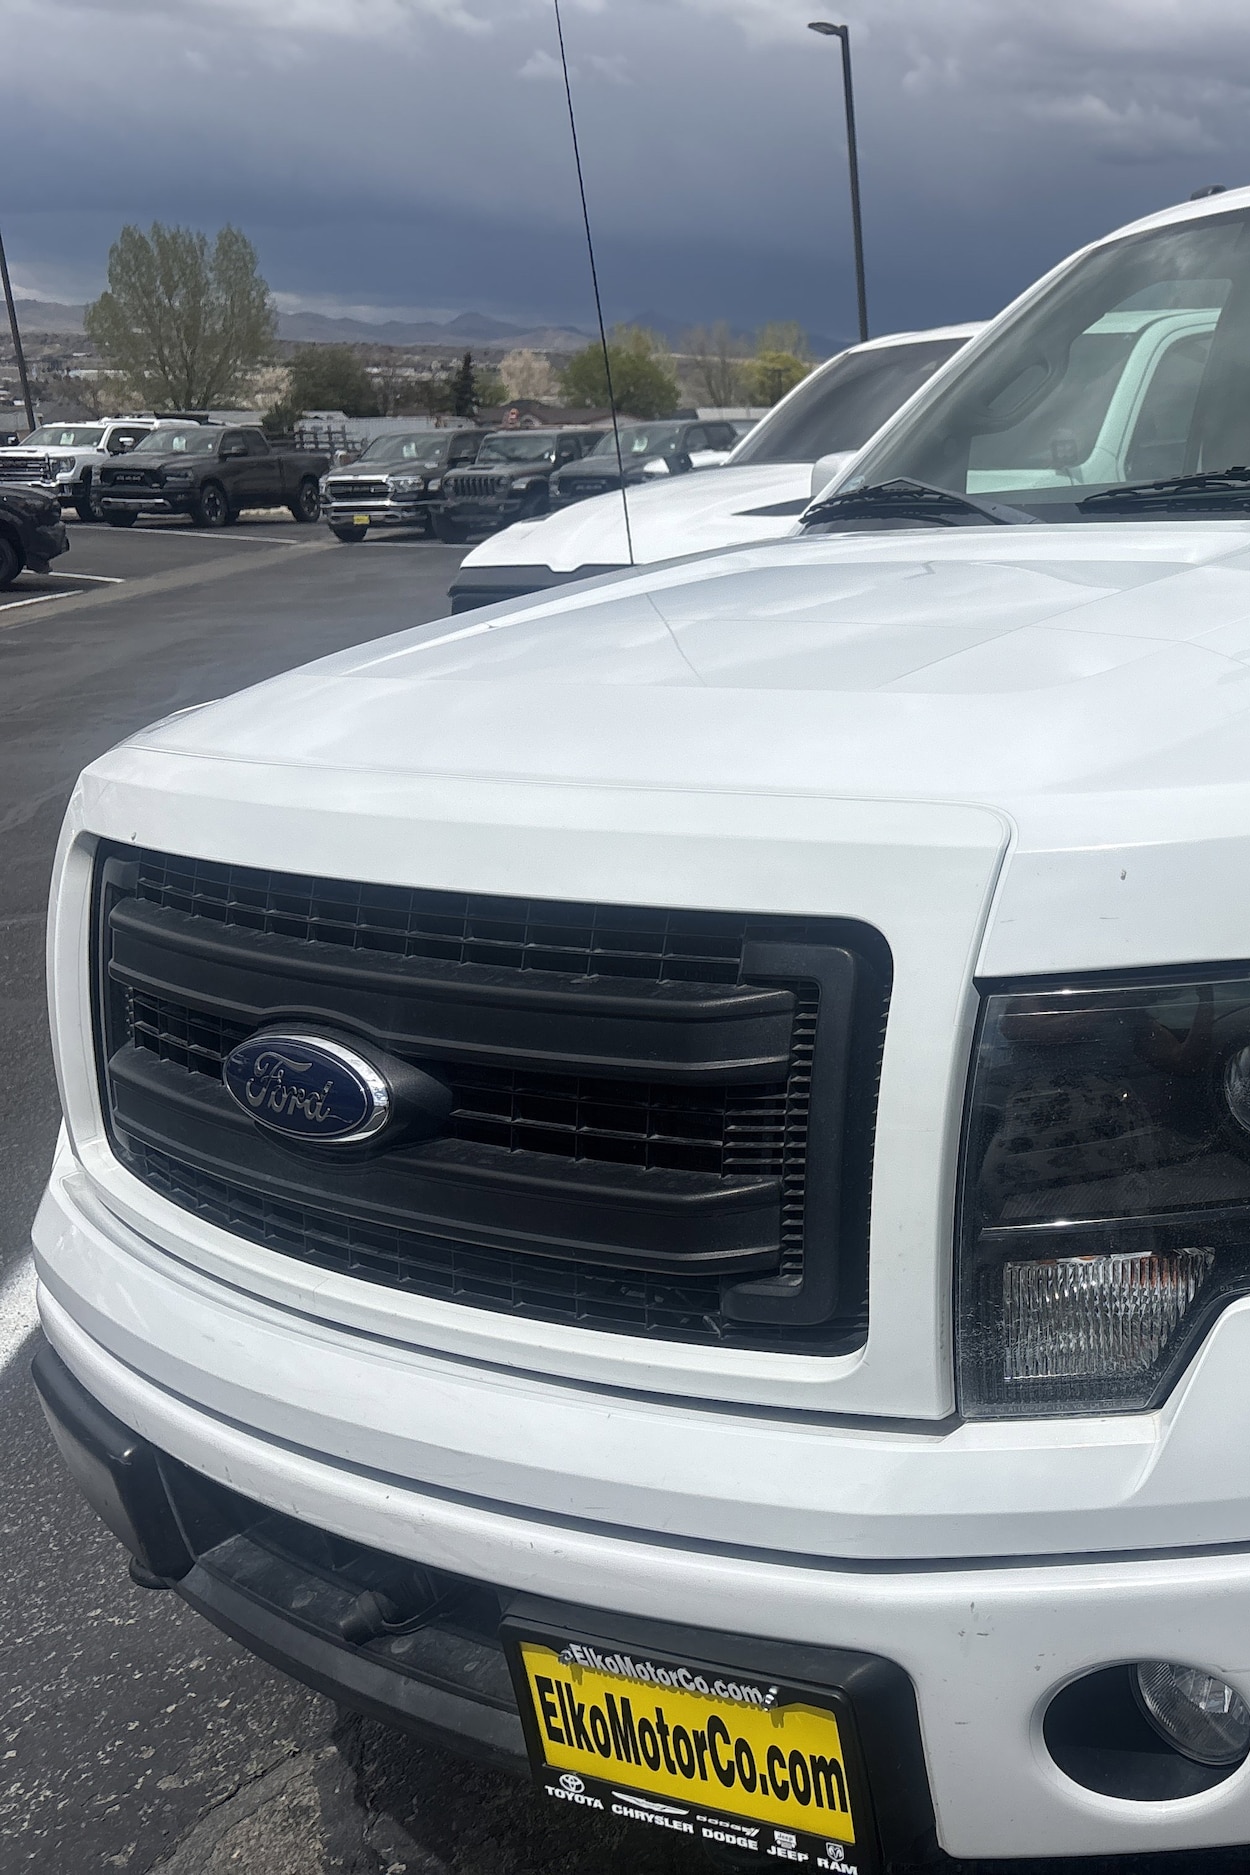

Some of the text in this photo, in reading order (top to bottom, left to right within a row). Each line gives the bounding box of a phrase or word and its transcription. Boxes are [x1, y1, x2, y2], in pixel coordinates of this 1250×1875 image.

[246, 1051, 352, 1123] Ford
[569, 1642, 763, 1703] ElkoMotorCo.com
[535, 1674, 849, 1814] ElkoMotorCo.com
[545, 1785, 858, 1875] TOYOTA CHRYSLER DODGE JEEP RAM
